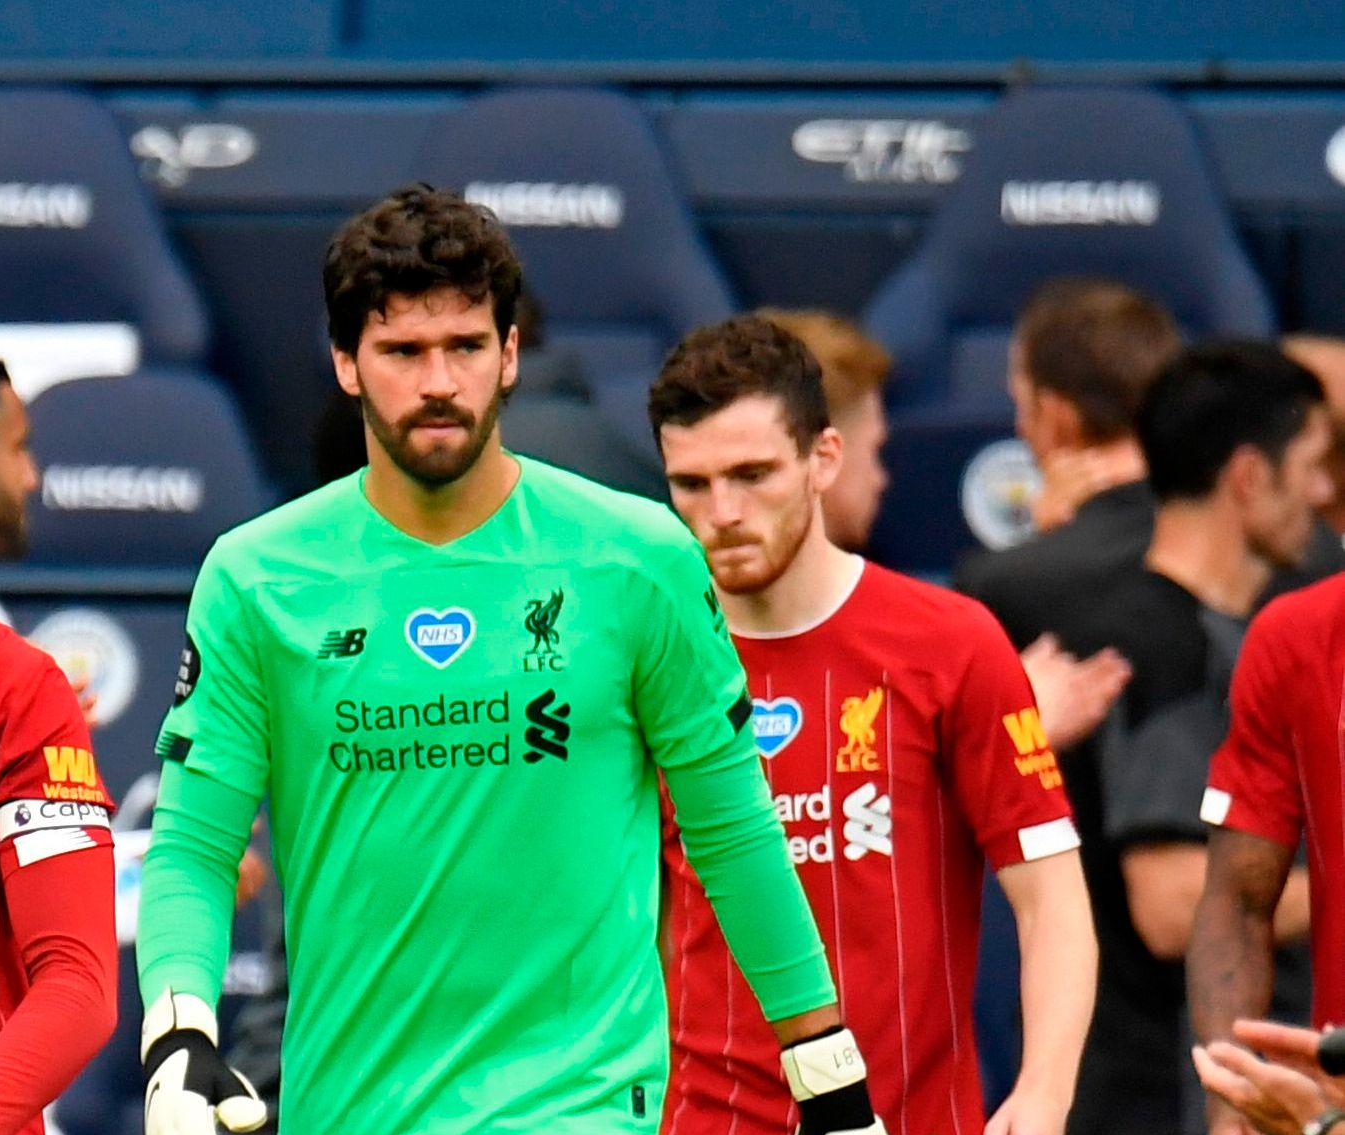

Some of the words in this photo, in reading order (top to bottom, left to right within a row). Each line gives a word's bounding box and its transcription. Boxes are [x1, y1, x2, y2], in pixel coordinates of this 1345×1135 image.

[1001, 180, 1160, 226] NISSAN
[42, 464, 204, 512] NISSAN
[420, 627, 461, 643] NHS
[335, 690, 510, 734] Standard
[328, 733, 510, 774] Chartered
